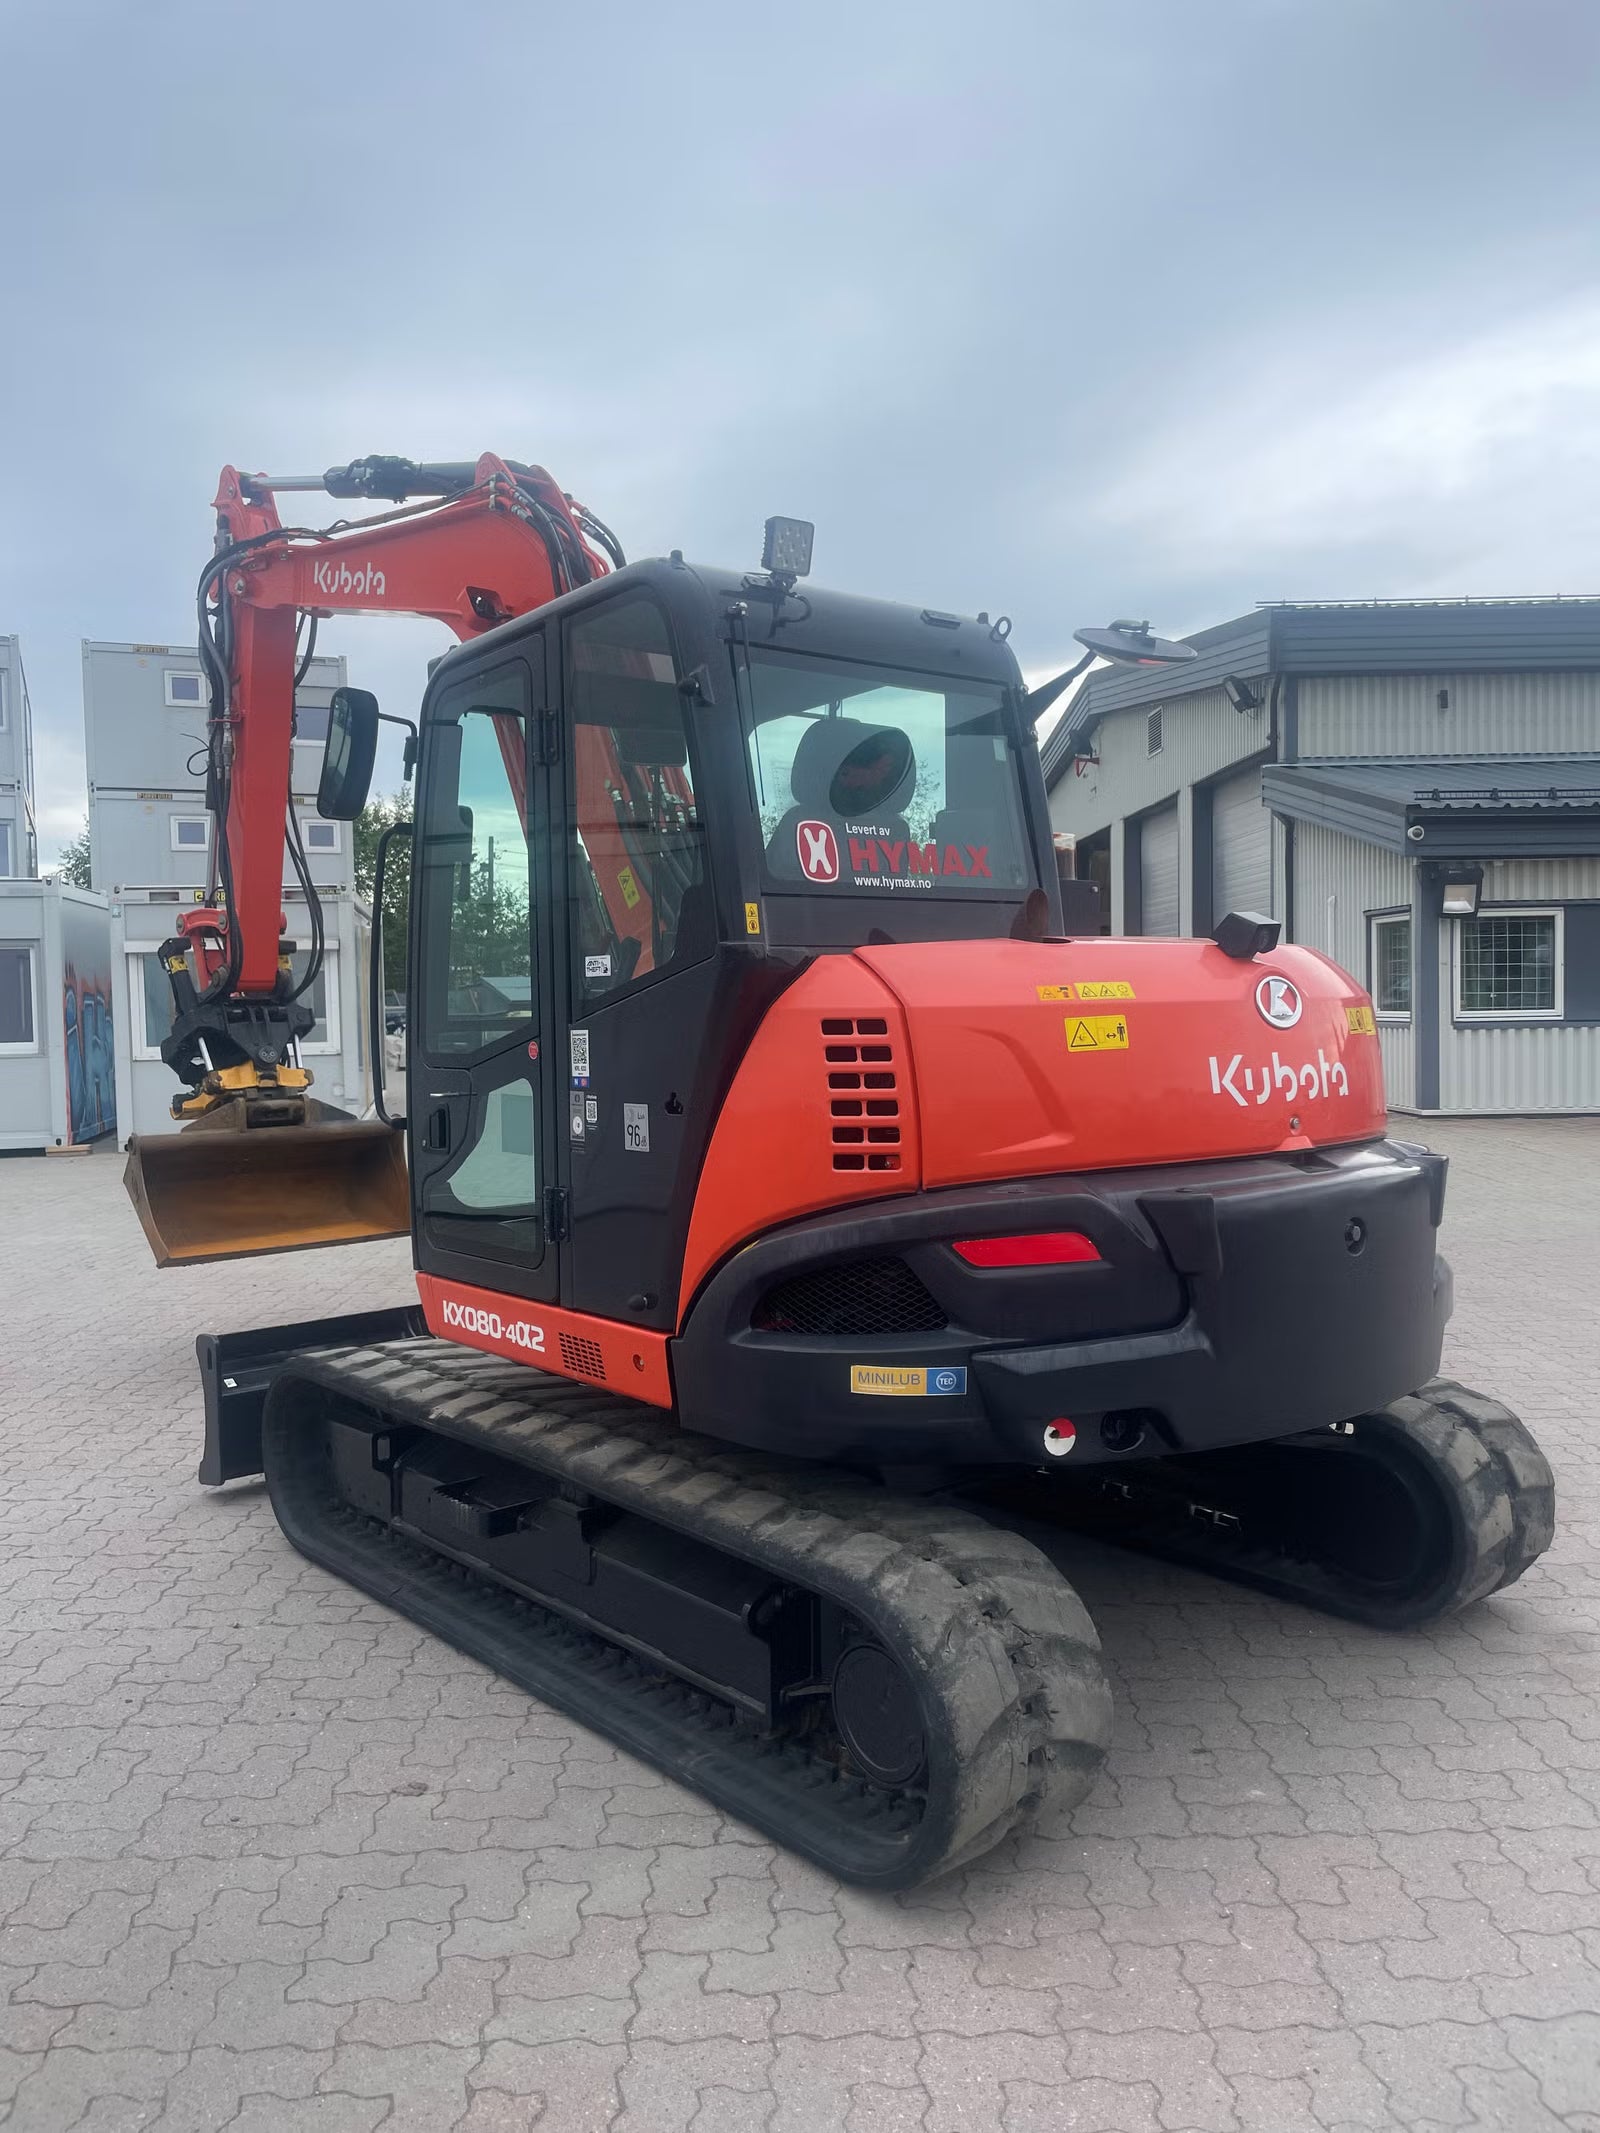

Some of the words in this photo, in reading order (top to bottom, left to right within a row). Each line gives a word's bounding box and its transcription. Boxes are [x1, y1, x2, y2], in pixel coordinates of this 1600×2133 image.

[314, 561, 385, 595] Kubota
[845, 822, 877, 836] Levert
[879, 826, 890, 836] av
[848, 838, 993, 878] HYMAX
[854, 875, 932, 890] www.hymax.no
[1209, 1049, 1349, 1107] Kubota
[627, 1124, 641, 1147] 96
[858, 1371, 921, 1386] MINILUB
[940, 1378, 954, 1386] TEC
